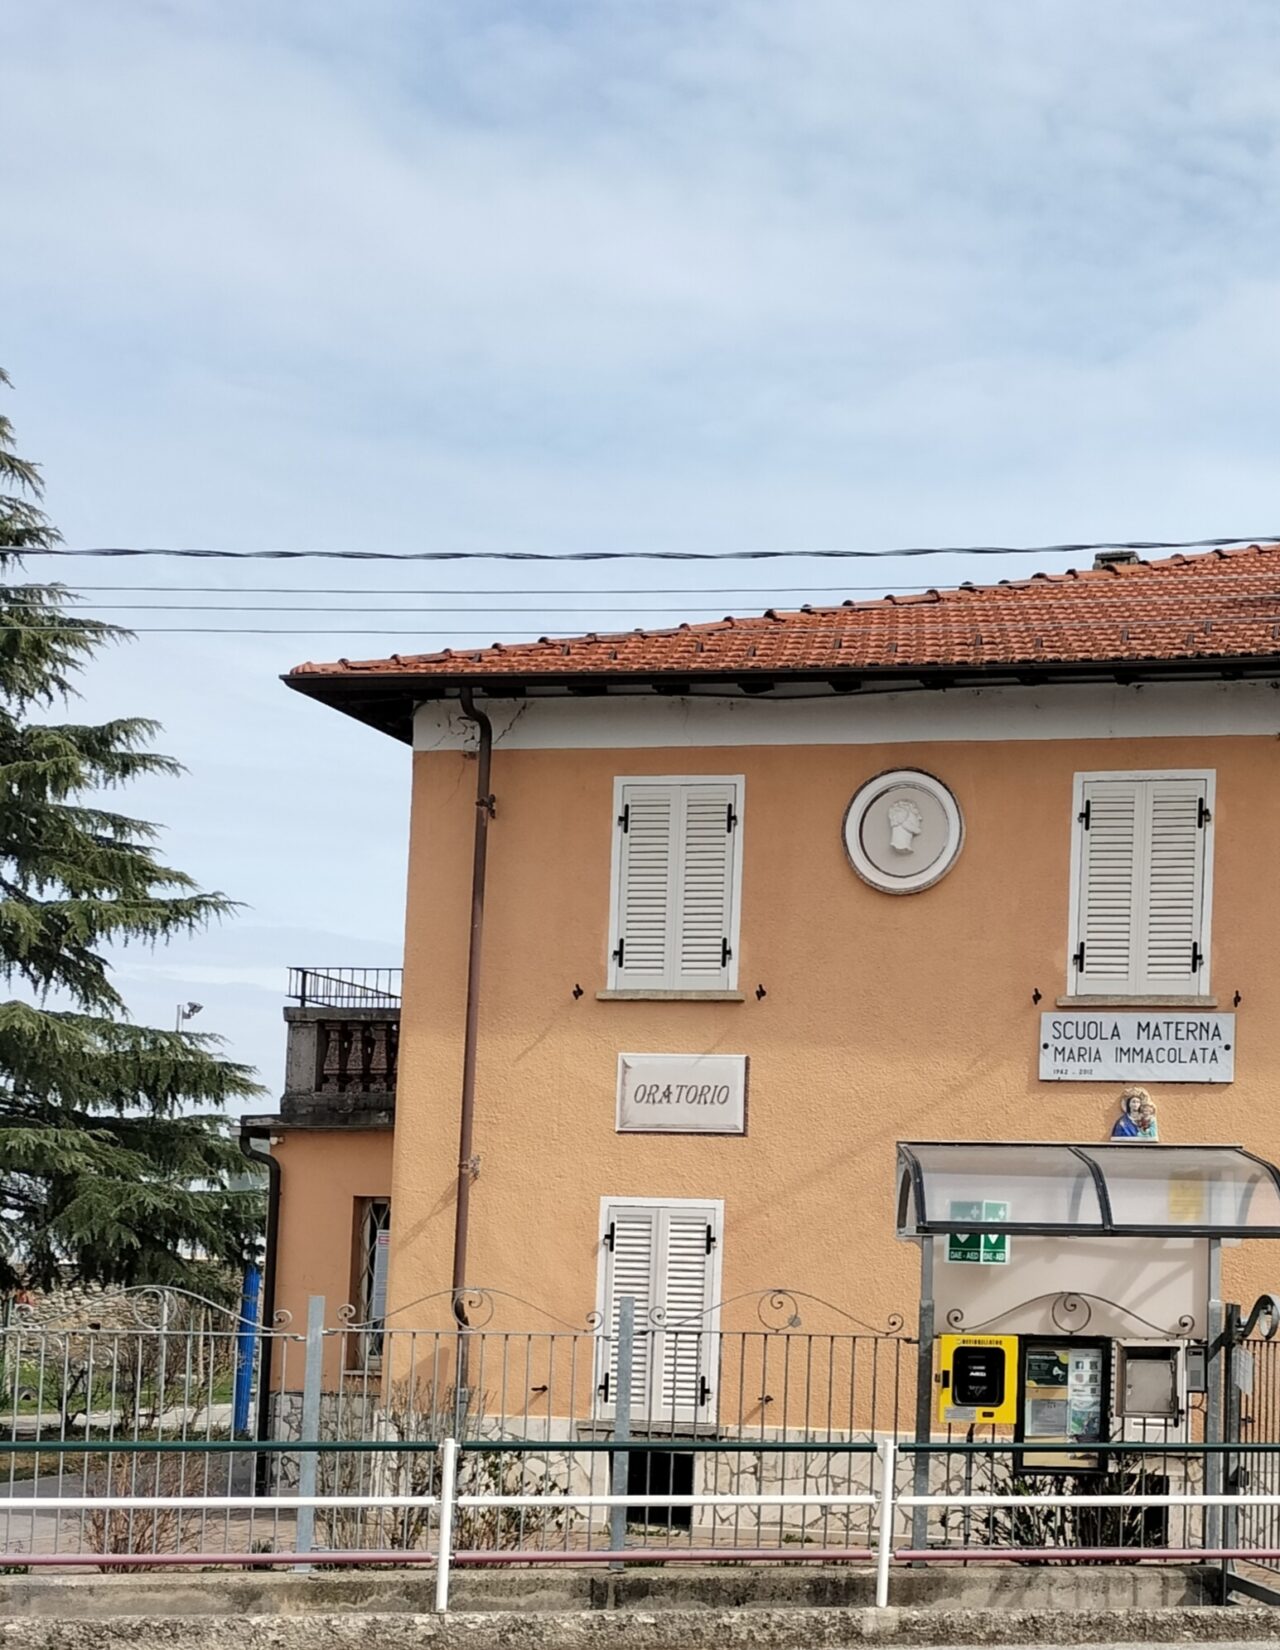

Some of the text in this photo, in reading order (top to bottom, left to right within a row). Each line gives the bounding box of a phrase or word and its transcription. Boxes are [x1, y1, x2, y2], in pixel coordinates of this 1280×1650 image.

[1052, 1021, 1222, 1041] SCUOLA MATERNA
[634, 1084, 730, 1105] ORATORIO
[950, 1251, 963, 1259] DAE
[966, 1251, 979, 1260] AED
